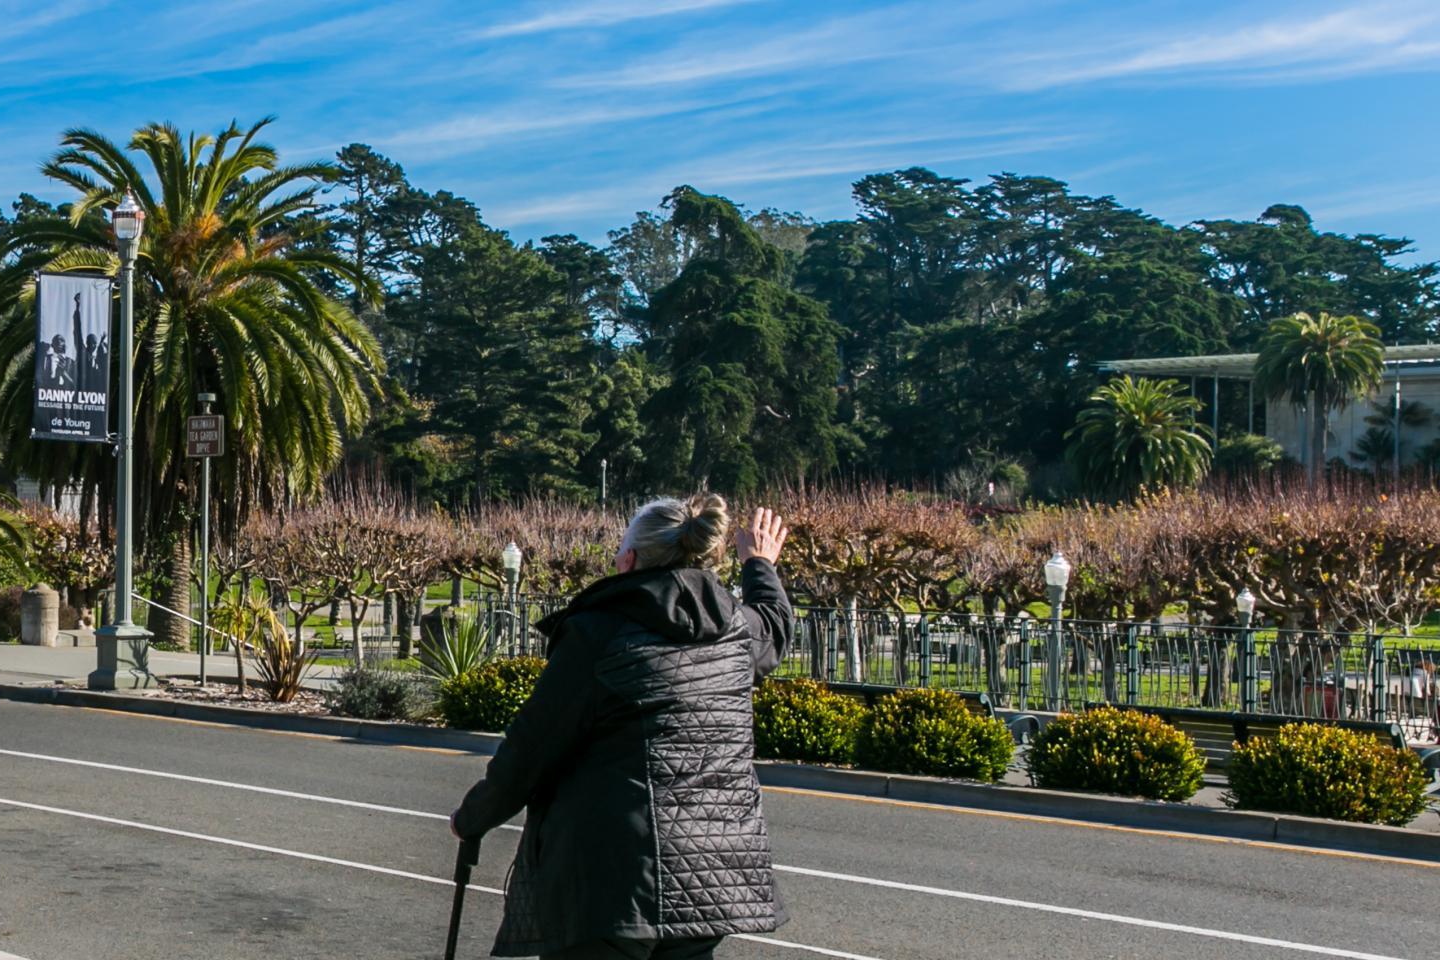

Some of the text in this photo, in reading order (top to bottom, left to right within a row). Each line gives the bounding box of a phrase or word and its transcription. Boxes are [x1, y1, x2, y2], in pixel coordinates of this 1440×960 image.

[38, 388, 106, 405] DANNY LYON
[38, 401, 63, 409] MESSAGE
[64, 402, 72, 410] TO
[84, 404, 105, 412] FUTURE
[51, 416, 91, 430] de Young
[189, 431, 218, 442] TEA GARDEN
